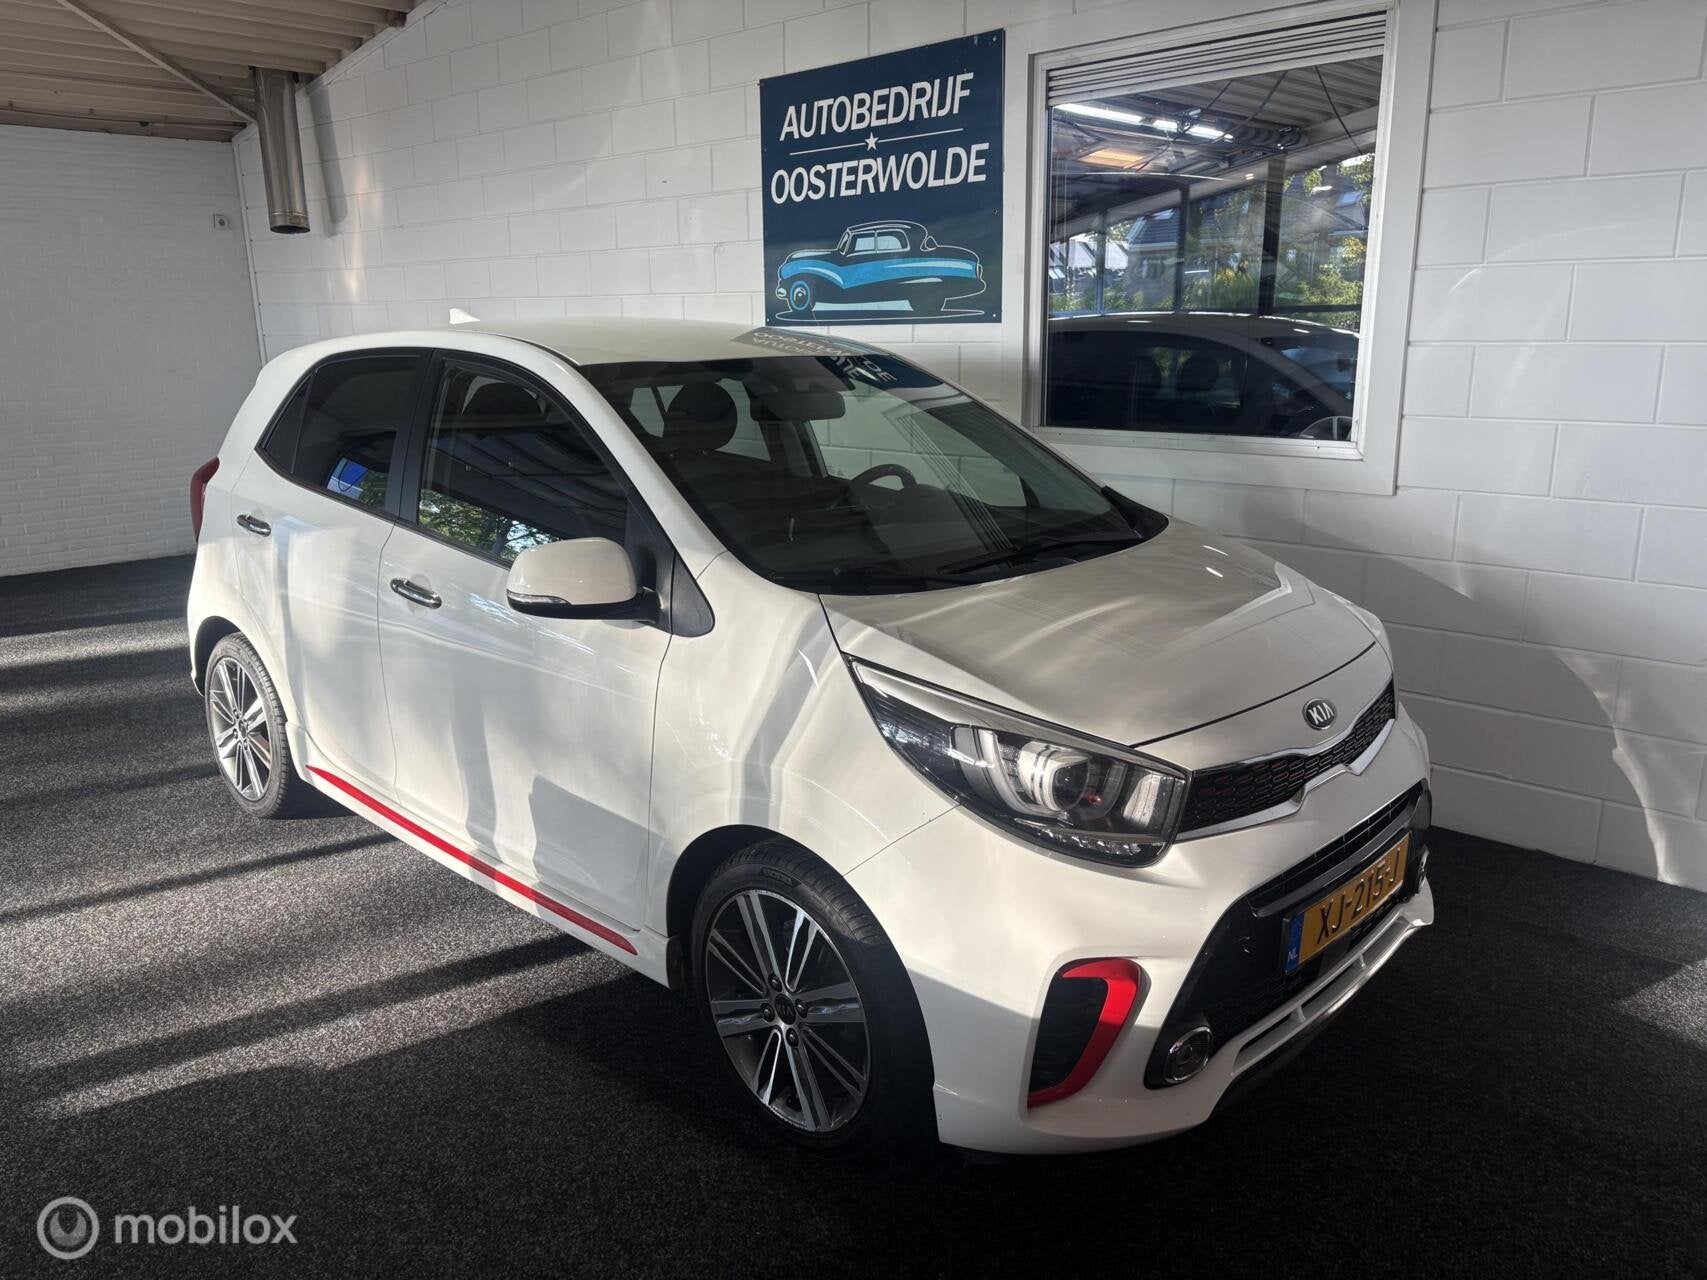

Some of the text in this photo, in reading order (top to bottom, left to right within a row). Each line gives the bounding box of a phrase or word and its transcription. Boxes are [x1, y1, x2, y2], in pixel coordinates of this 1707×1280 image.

[780, 72, 974, 142] AUTOBEDRIJF
[770, 142, 990, 205] OOSTERWOLDE
[1308, 702, 1335, 725] KIA
[1316, 848, 1401, 945] XJ-215-J
[1287, 947, 1299, 962] NL
